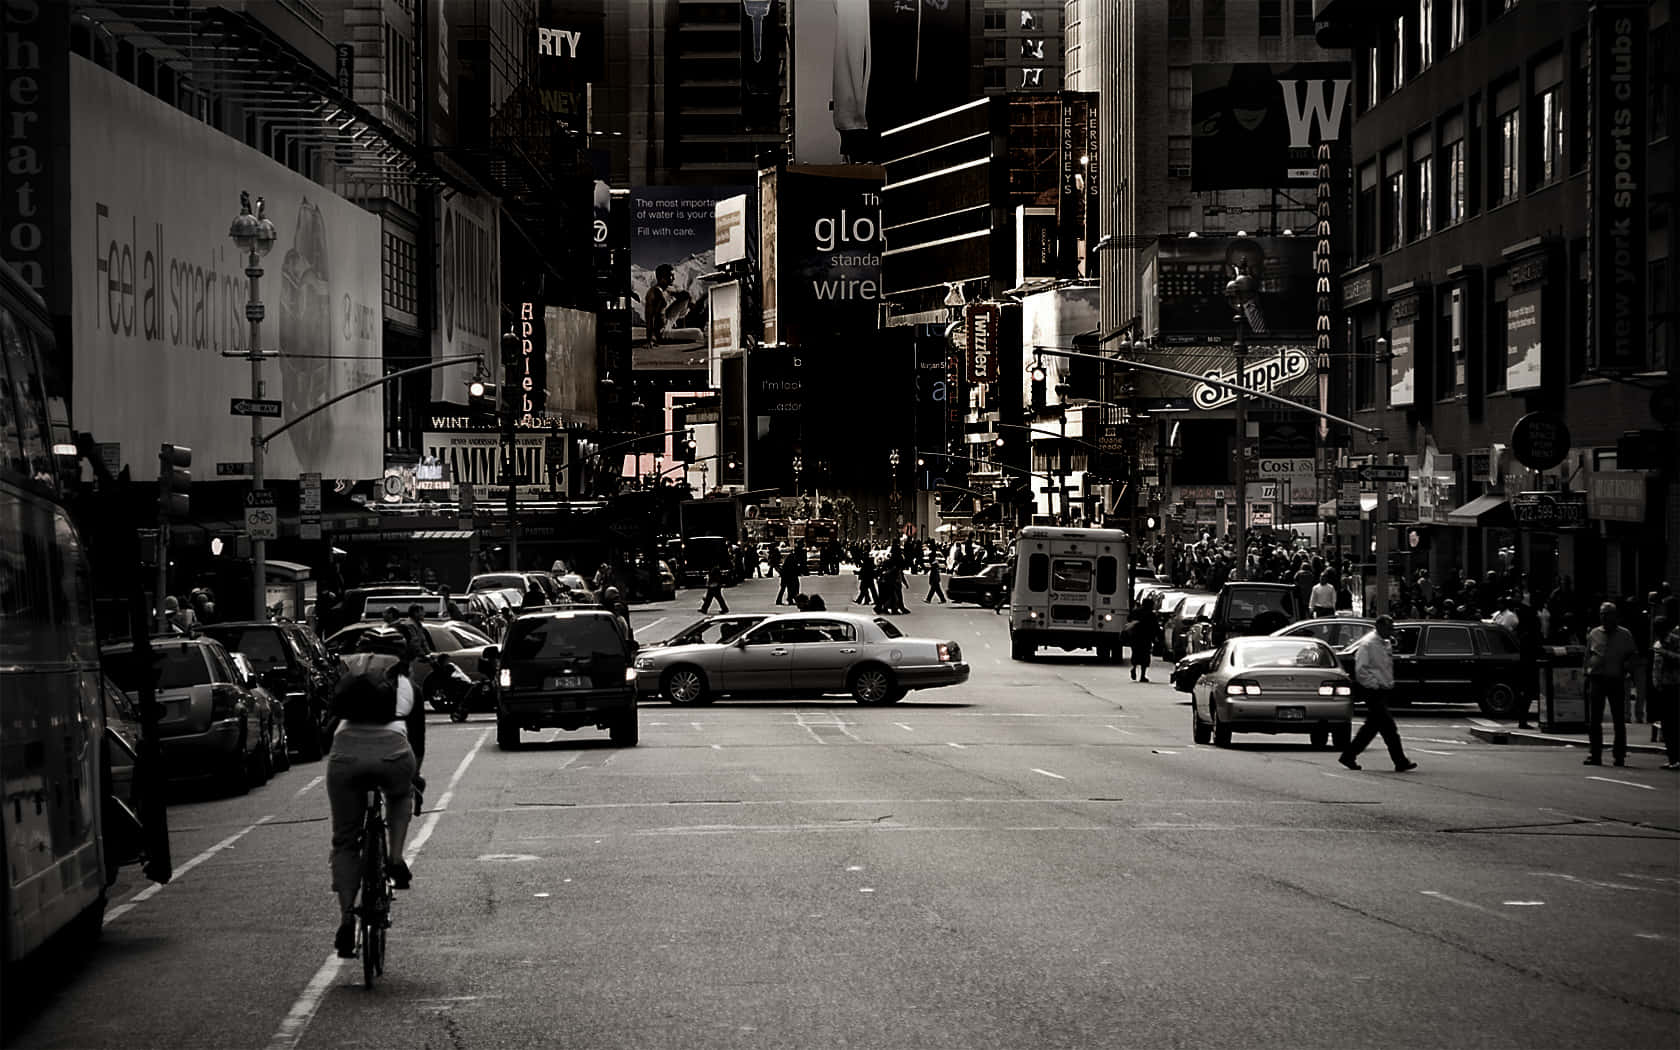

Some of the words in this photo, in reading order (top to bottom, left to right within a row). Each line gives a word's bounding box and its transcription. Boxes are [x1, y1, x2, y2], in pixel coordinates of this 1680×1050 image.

[538, 27, 581, 58] RTY
[1610, 16, 1633, 101] clubs
[1277, 79, 1352, 149] W
[1610, 107, 1637, 209] sports
[637, 199, 653, 208] The
[656, 199, 678, 208] most
[637, 210, 646, 219] of
[648, 211, 673, 219] water
[677, 210, 684, 219] is
[687, 212, 707, 221] your
[637, 228, 650, 237] Fill
[653, 228, 671, 237] with
[674, 229, 697, 237] care.
[96, 202, 137, 337] Feel
[144, 226, 165, 342] all
[170, 248, 218, 353] smart
[1610, 216, 1638, 287] york
[974, 311, 991, 377] Twizzlers
[1615, 293, 1633, 356] new
[1199, 350, 1302, 404] Snapple
